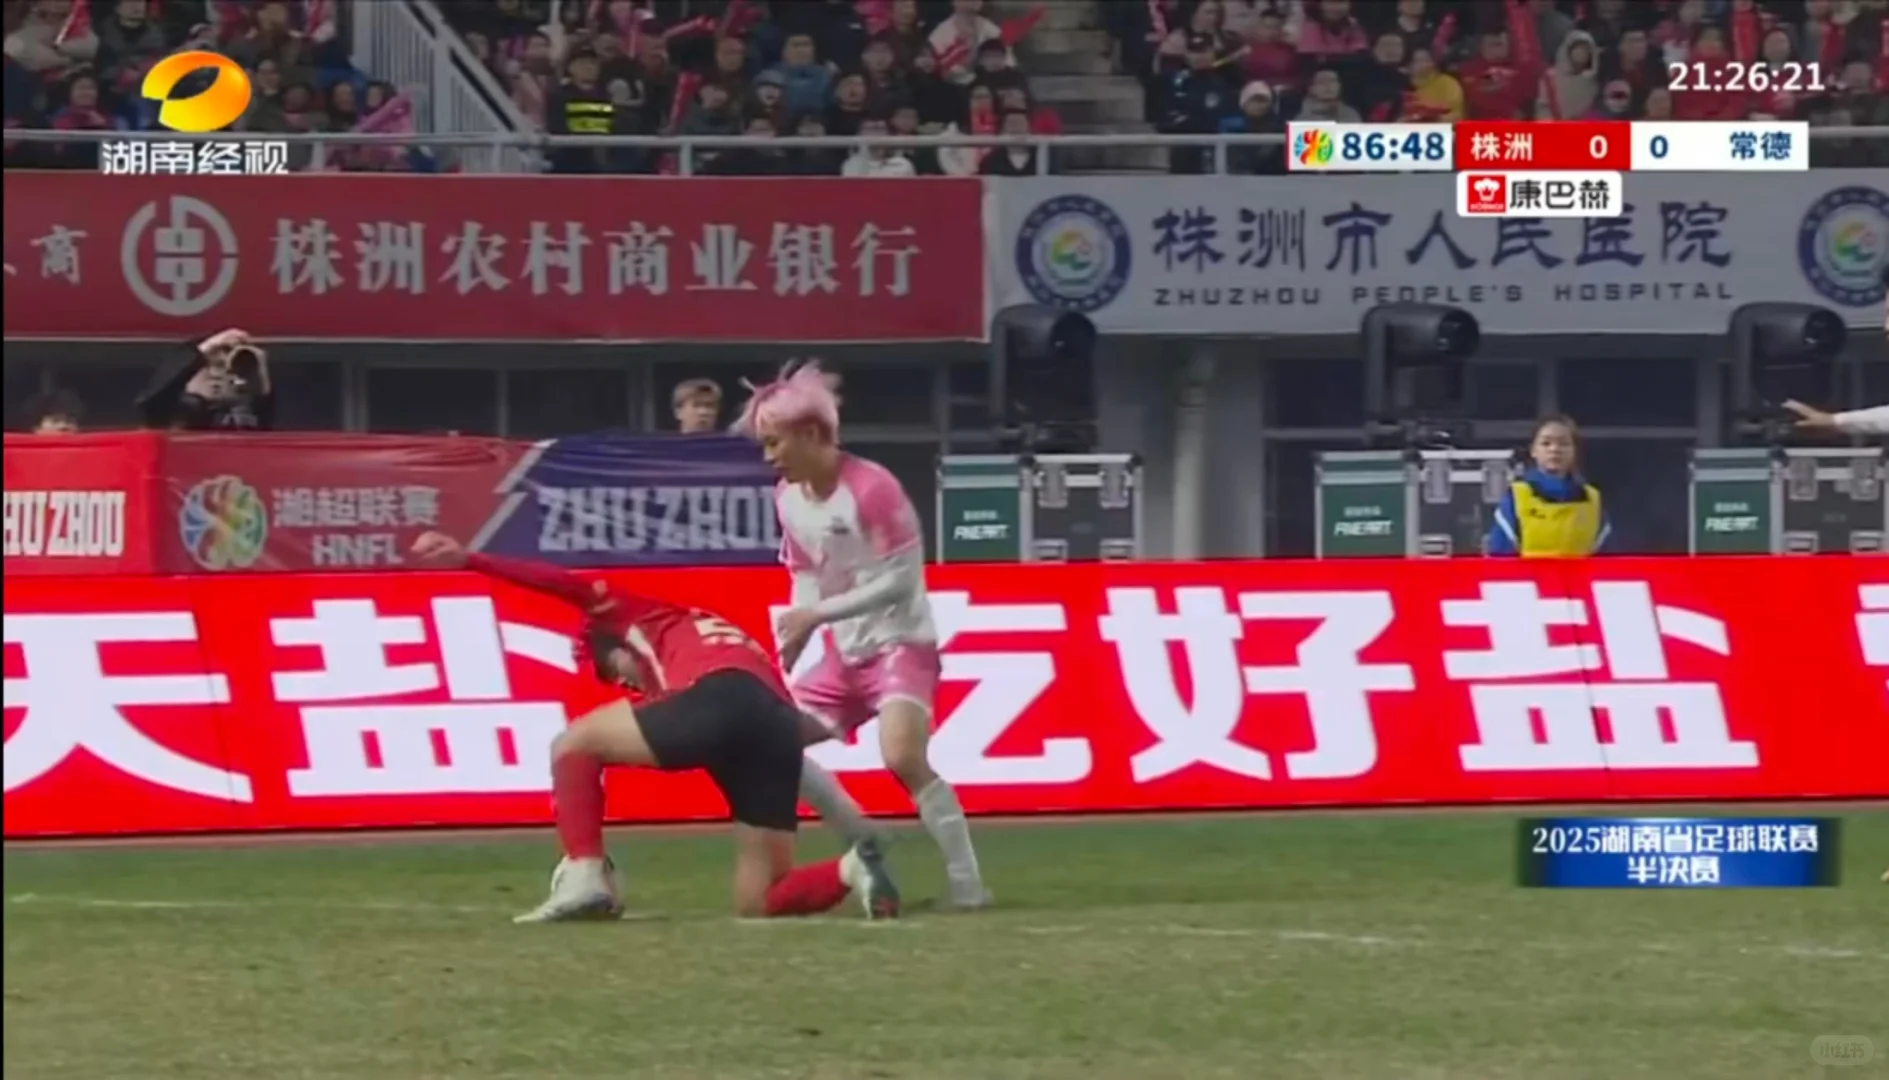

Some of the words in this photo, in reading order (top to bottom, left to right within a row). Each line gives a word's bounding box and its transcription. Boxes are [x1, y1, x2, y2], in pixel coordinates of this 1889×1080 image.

[4, 224, 88, 287] 商
[271, 219, 921, 296] 株洲农村商业银行
[1153, 201, 1732, 275] 株洲市人民医院
[1153, 287, 1322, 306] ZHUZHOU
[1352, 284, 1523, 304] PEOPLE'S
[1555, 282, 1733, 301] HOSPITAL
